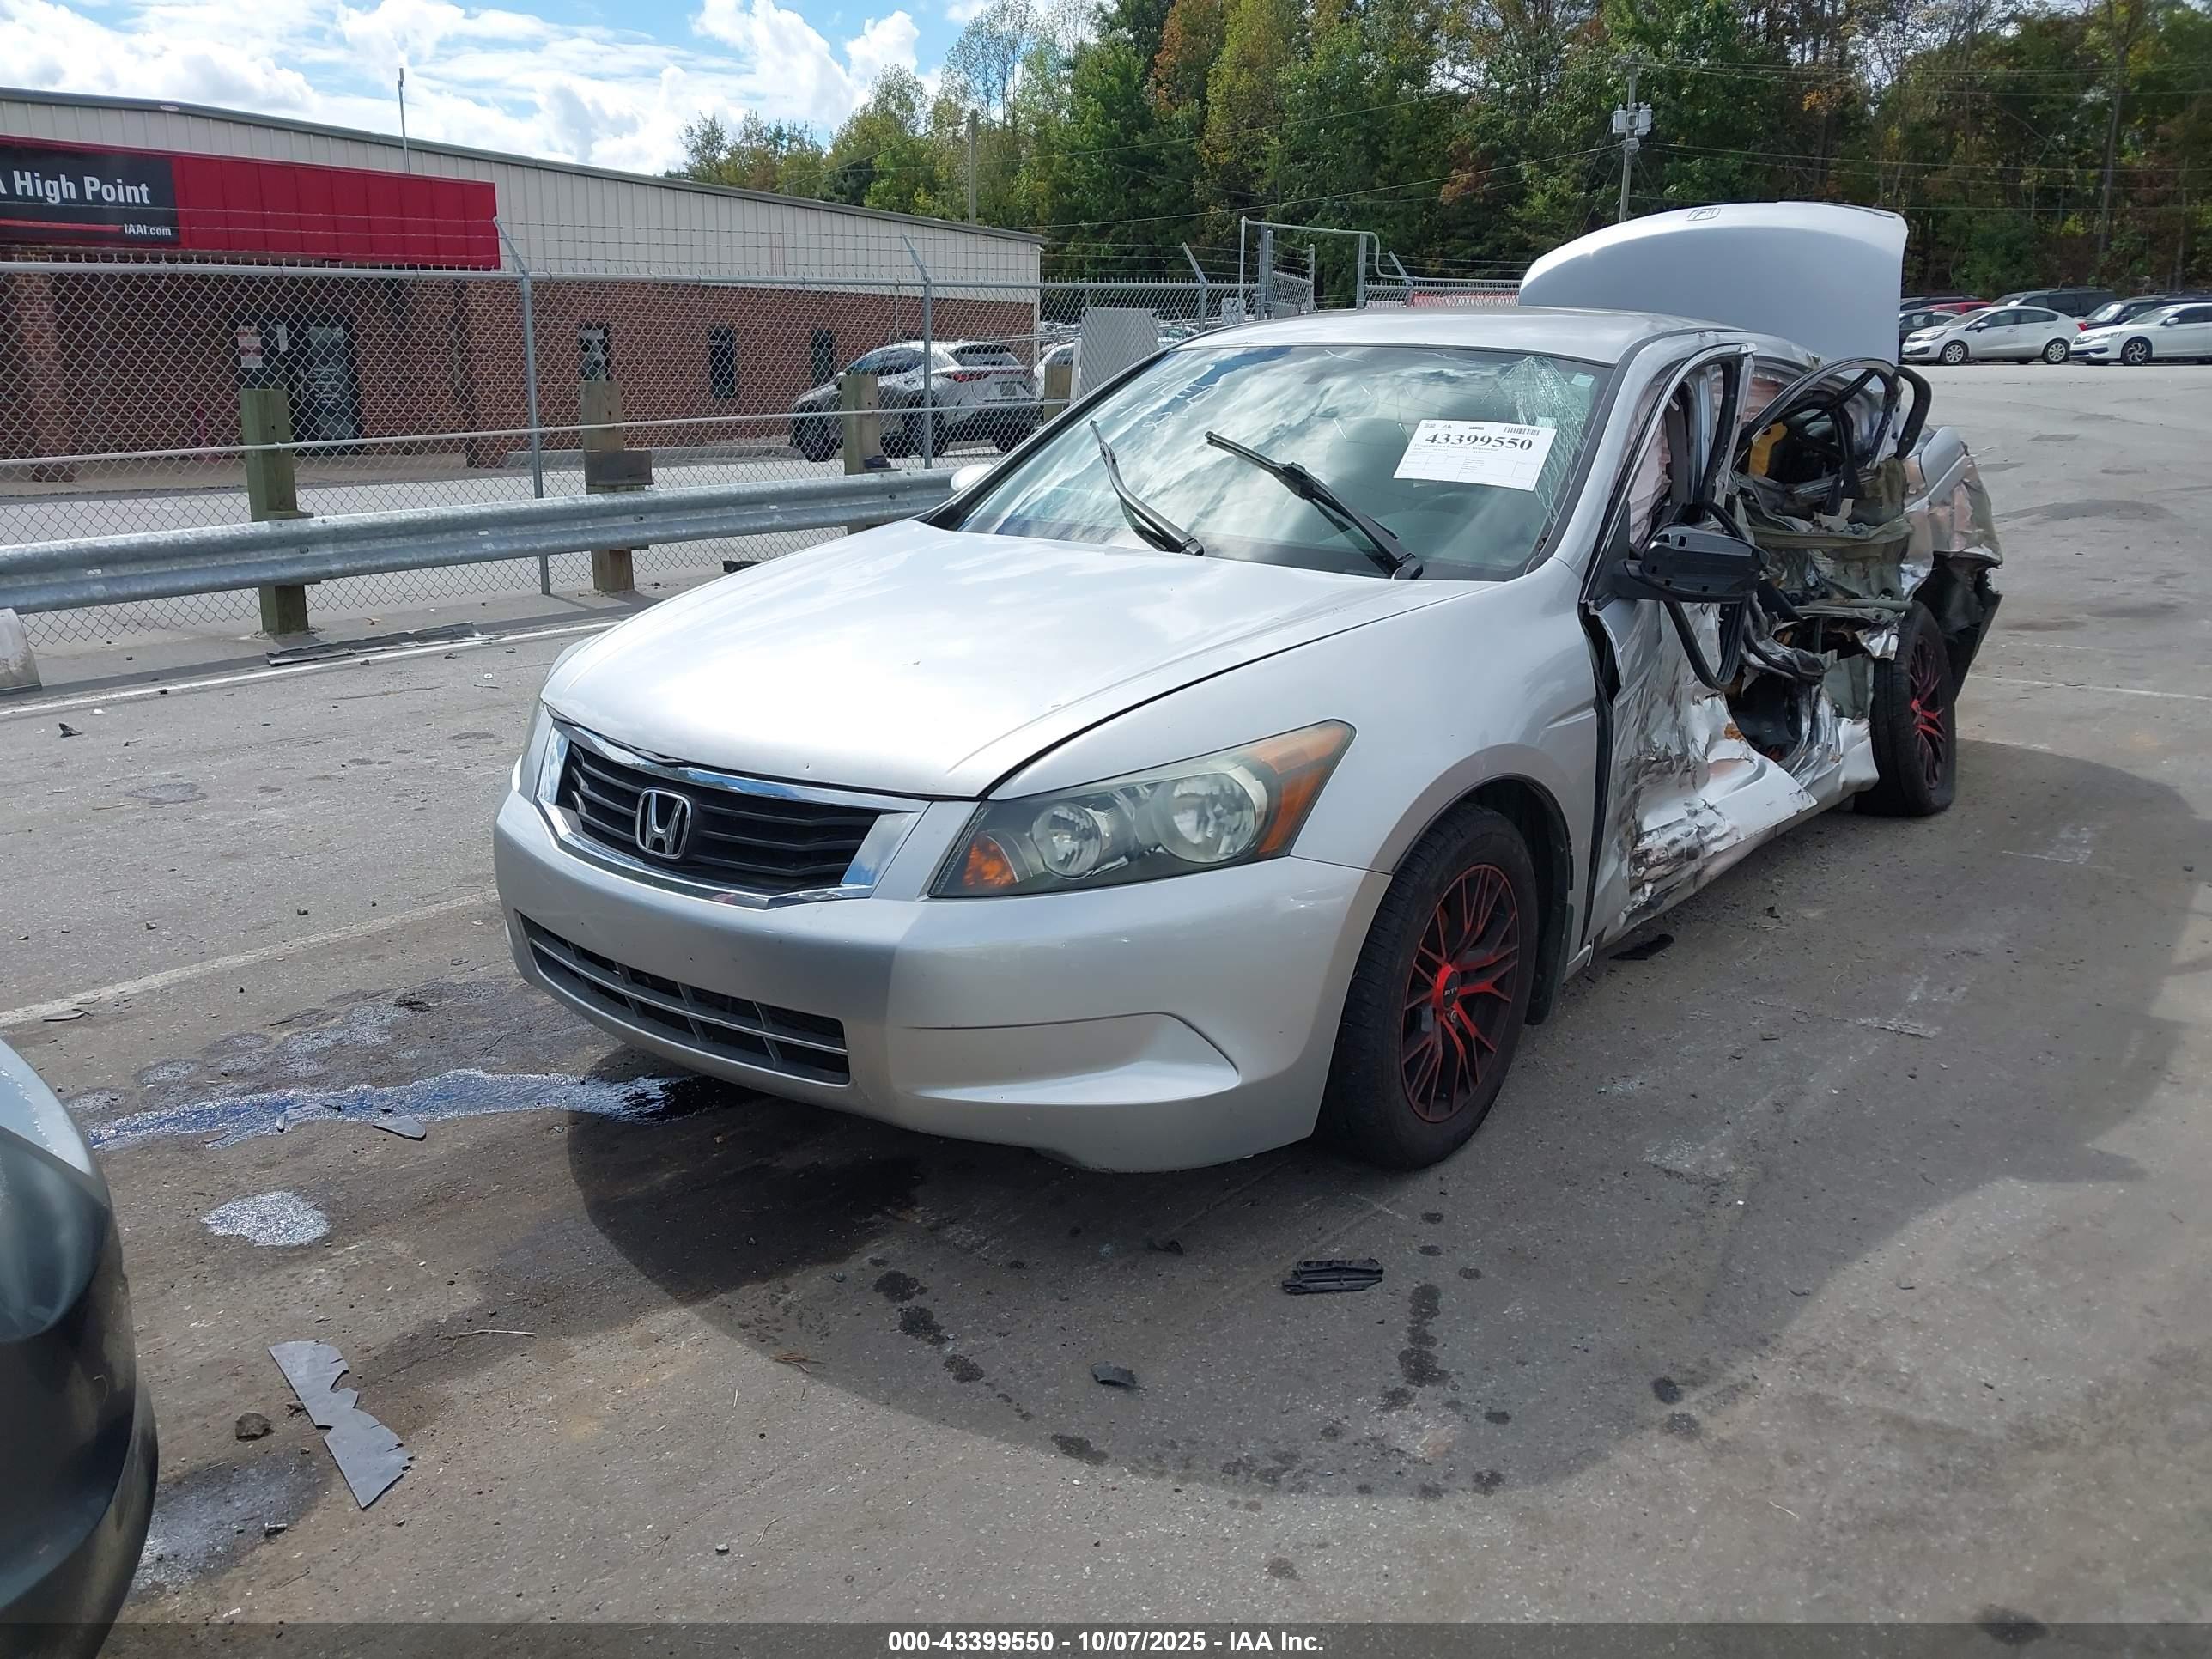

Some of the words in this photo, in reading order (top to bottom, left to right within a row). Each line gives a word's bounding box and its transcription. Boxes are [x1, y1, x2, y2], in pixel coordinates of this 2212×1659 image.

[14, 171, 76, 204] High
[83, 176, 150, 204] Point
[124, 223, 172, 236] IAAI.com
[1425, 432, 1533, 451] 43399550
